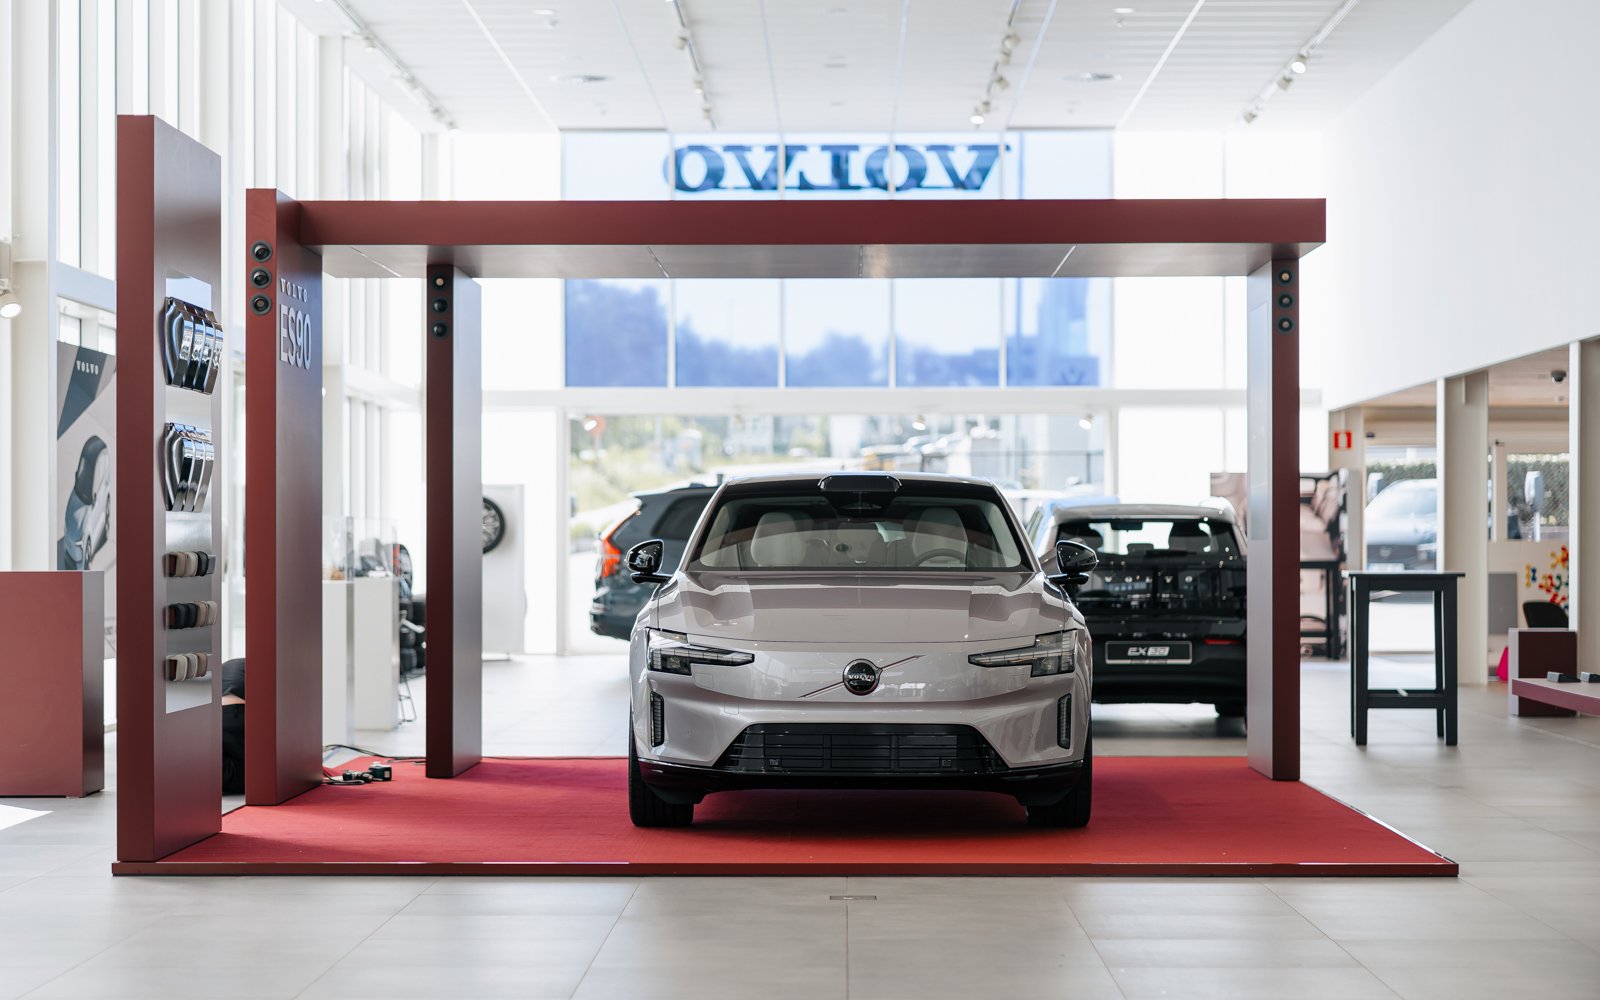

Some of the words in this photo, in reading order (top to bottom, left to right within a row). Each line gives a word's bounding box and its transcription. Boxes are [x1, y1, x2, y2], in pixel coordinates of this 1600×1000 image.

[280, 278, 308, 303] VOLVO
[280, 304, 312, 370] ES90
[76, 360, 99, 375] VOLVO
[848, 674, 875, 682] VOLVO
